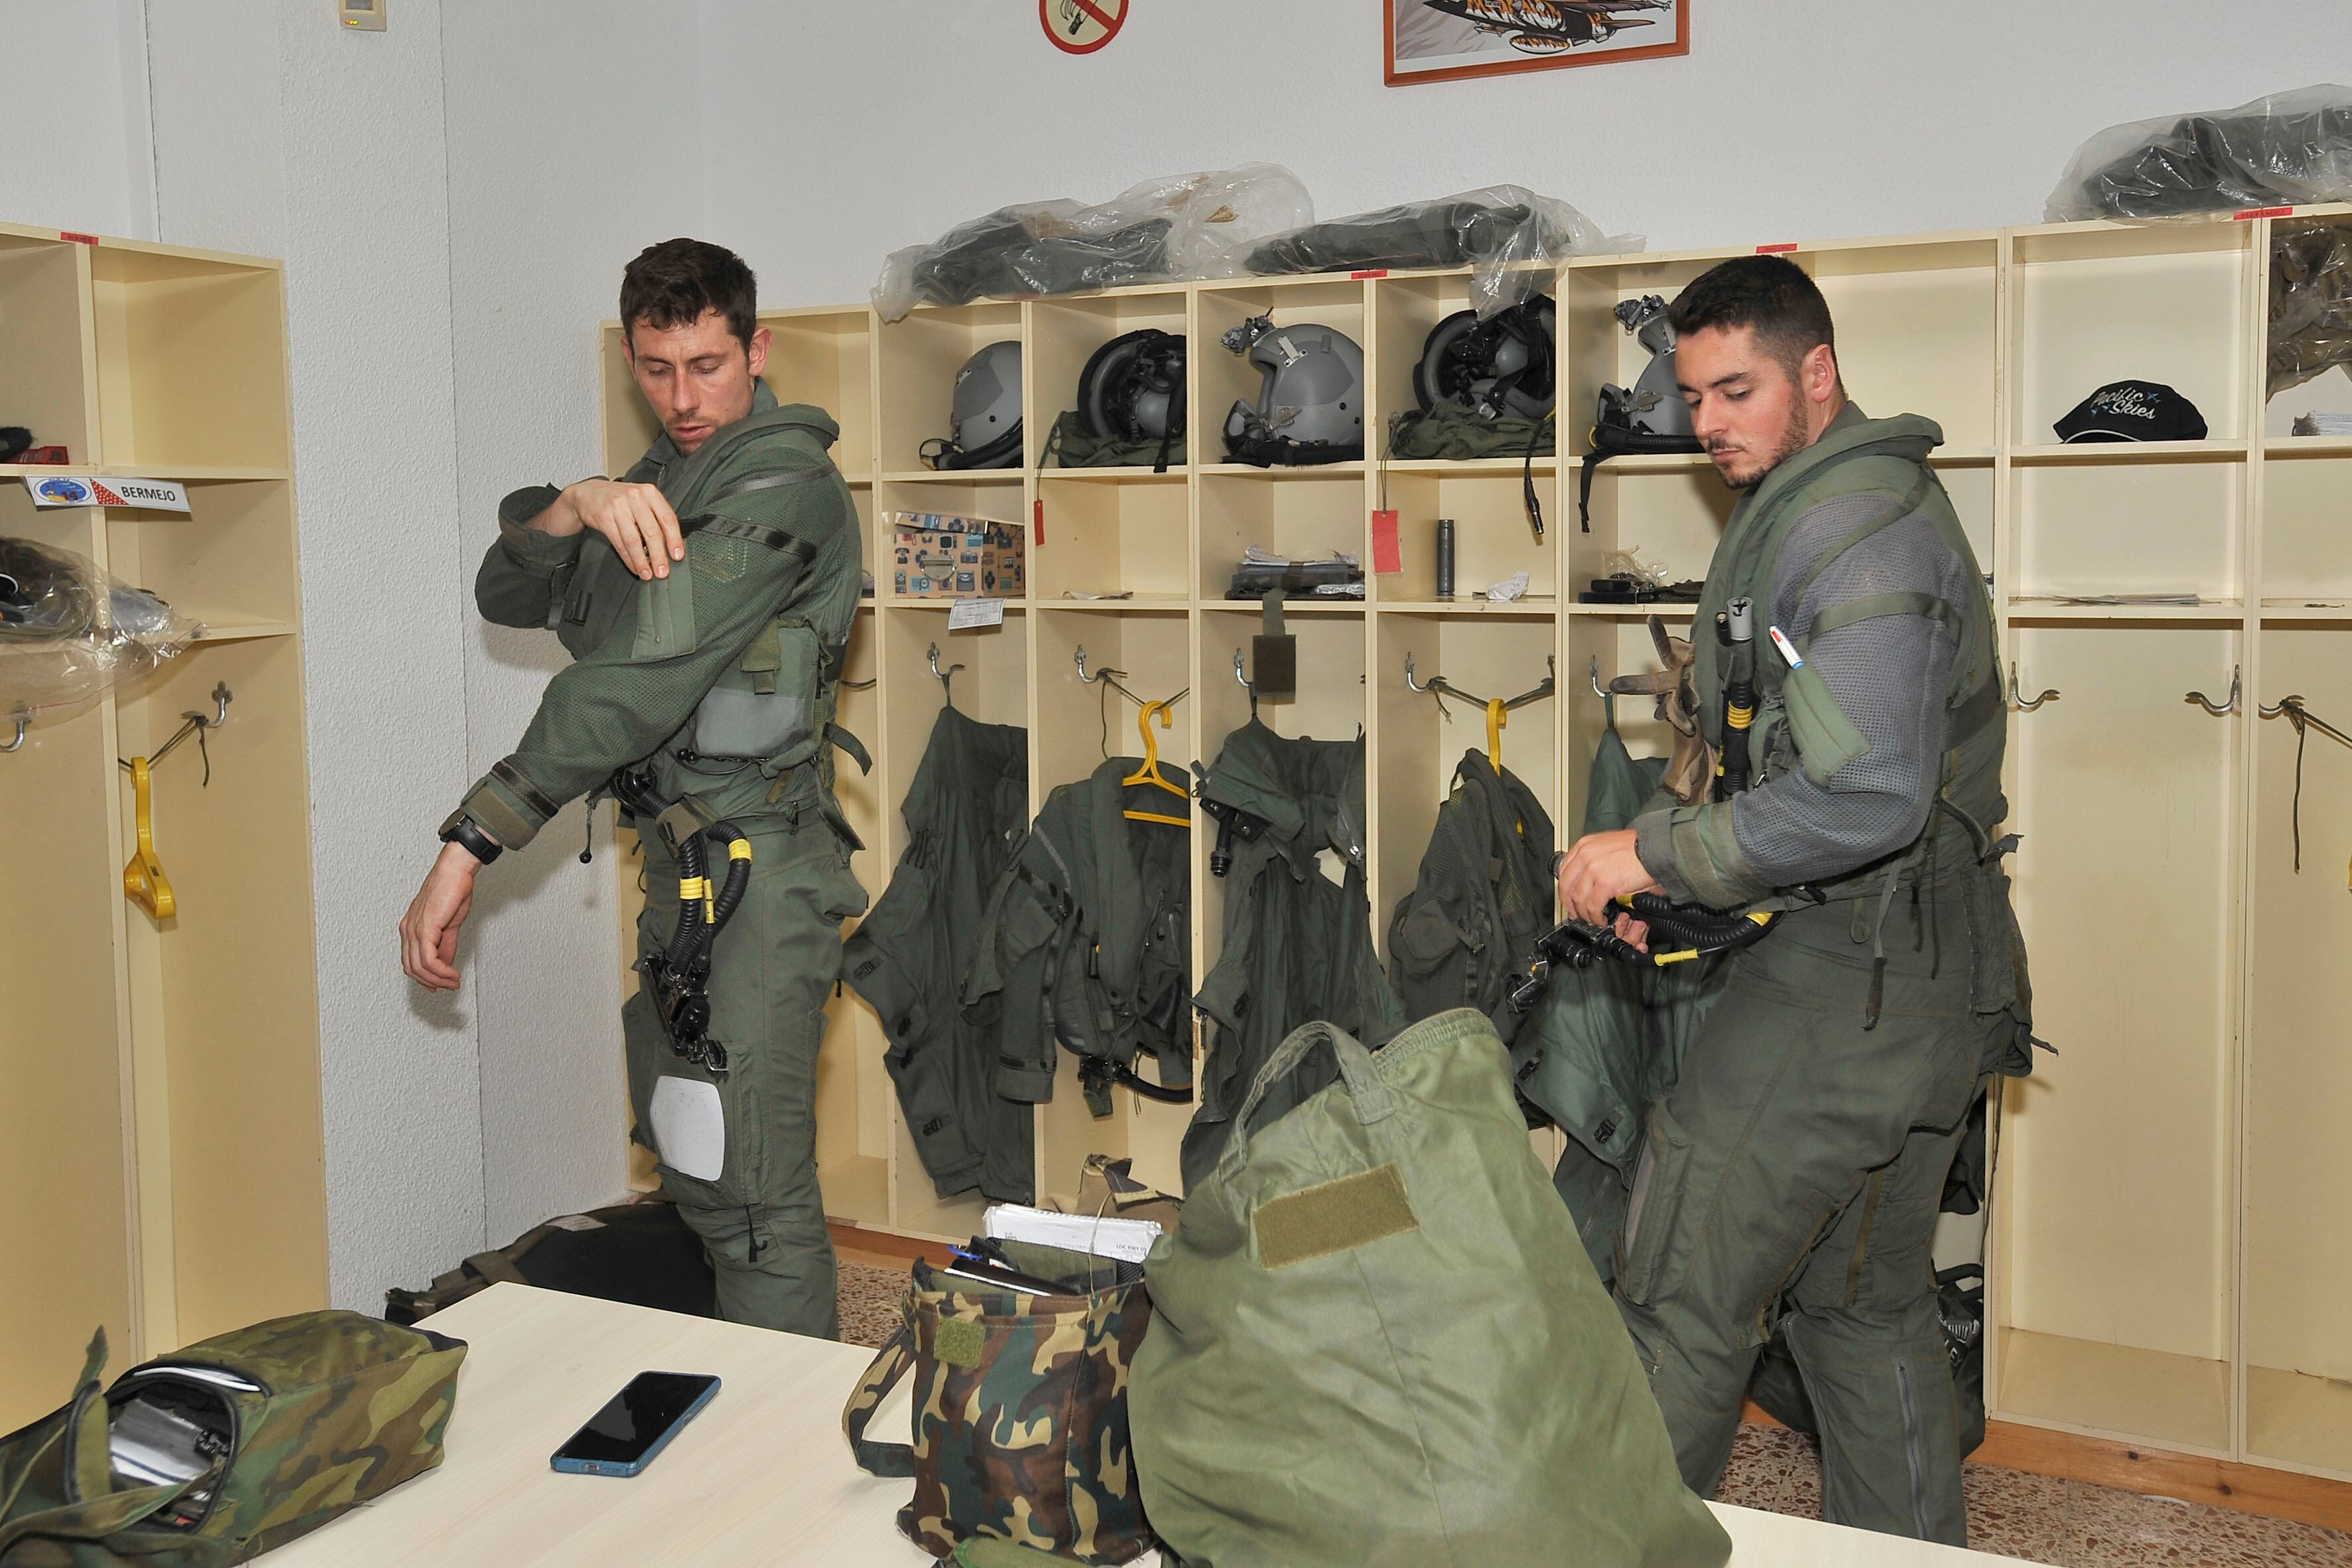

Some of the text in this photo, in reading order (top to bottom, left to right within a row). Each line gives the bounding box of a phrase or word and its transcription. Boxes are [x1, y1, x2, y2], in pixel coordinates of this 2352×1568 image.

[2090, 387, 2144, 408] Pacific
[2108, 399, 2156, 420] Skies
[121, 486, 176, 502] BERMEJO
